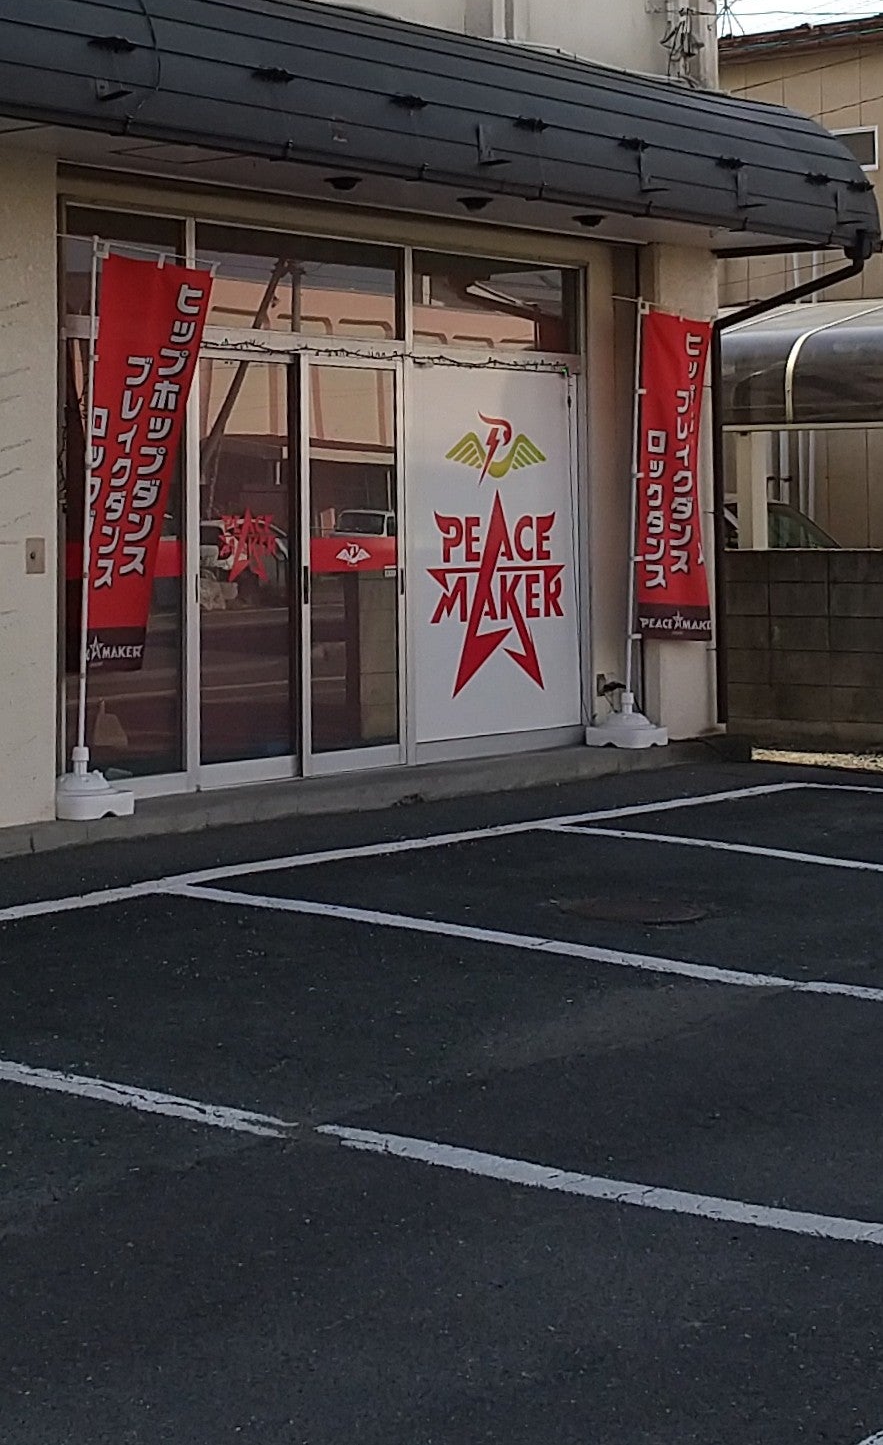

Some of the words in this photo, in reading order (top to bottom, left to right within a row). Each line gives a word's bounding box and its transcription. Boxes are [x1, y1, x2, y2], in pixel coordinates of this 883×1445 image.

[119, 284, 203, 575] ヒップホップダンス
[94, 356, 153, 588] ブレイクダンス
[434, 496, 555, 563] PEACE
[645, 429, 667, 588] ロックダンス
[430, 570, 565, 625] MAKER
[639, 618, 673, 629] PEACE
[102, 645, 144, 659] MAKER
